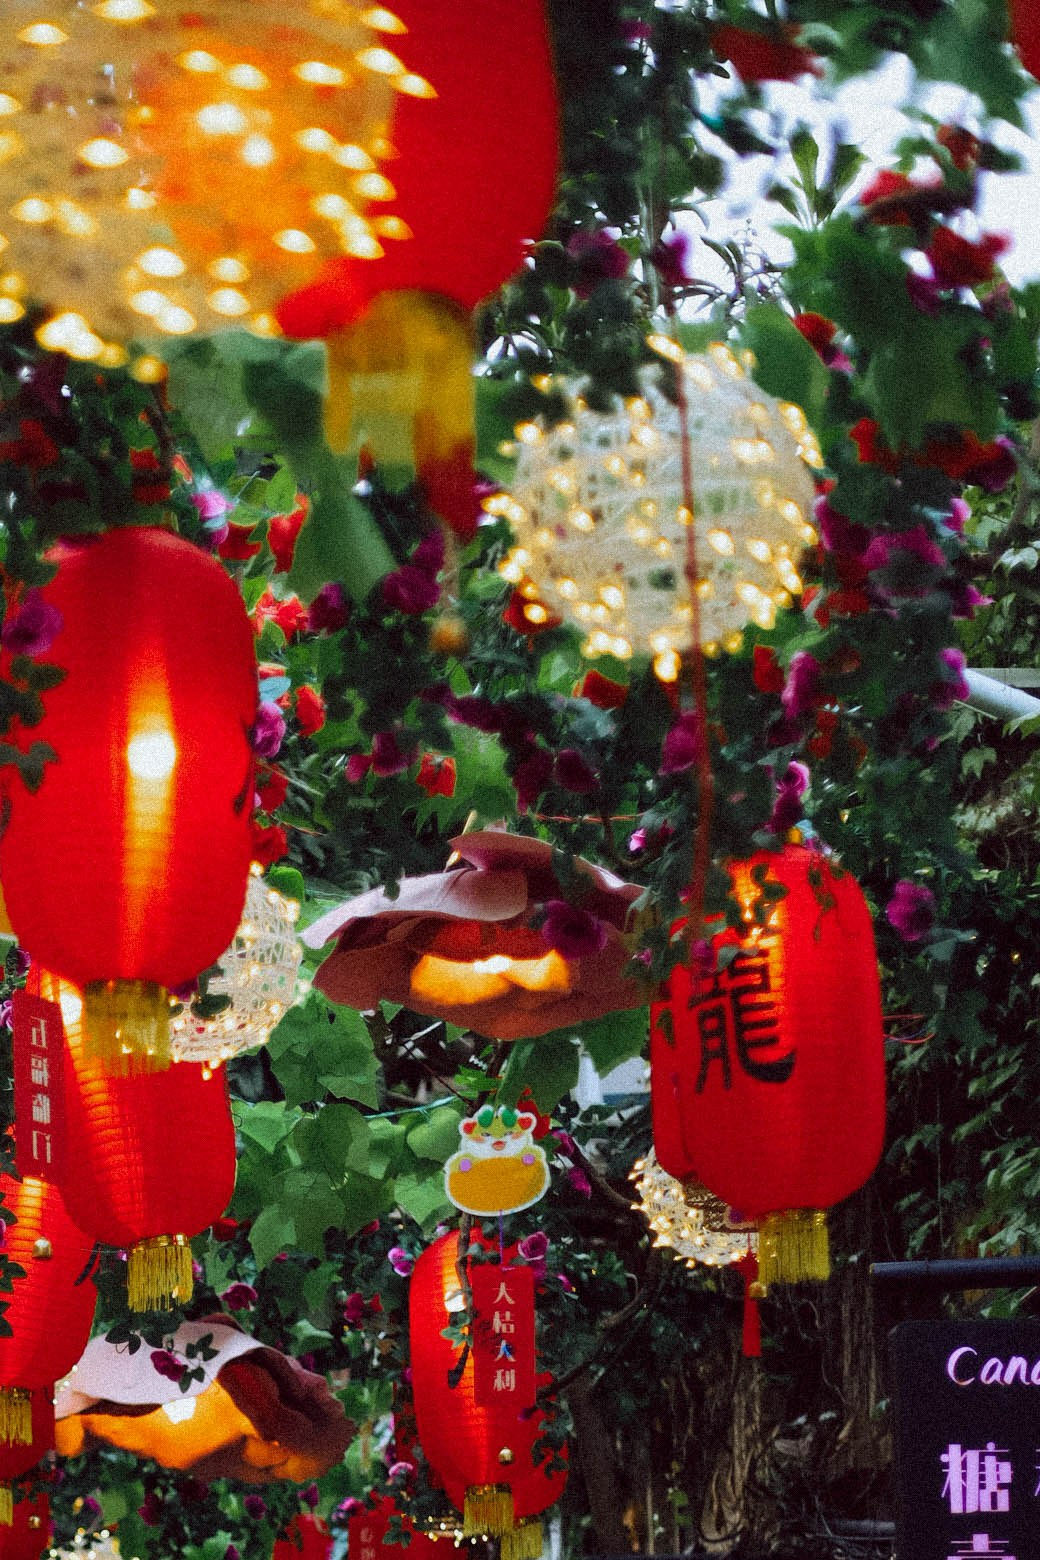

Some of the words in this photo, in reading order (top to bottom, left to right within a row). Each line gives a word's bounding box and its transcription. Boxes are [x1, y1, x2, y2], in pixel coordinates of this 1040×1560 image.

[492, 1281, 517, 1392] 大桔大利
[947, 1346, 1040, 1386] Can
[940, 1441, 1040, 1514] 糖
